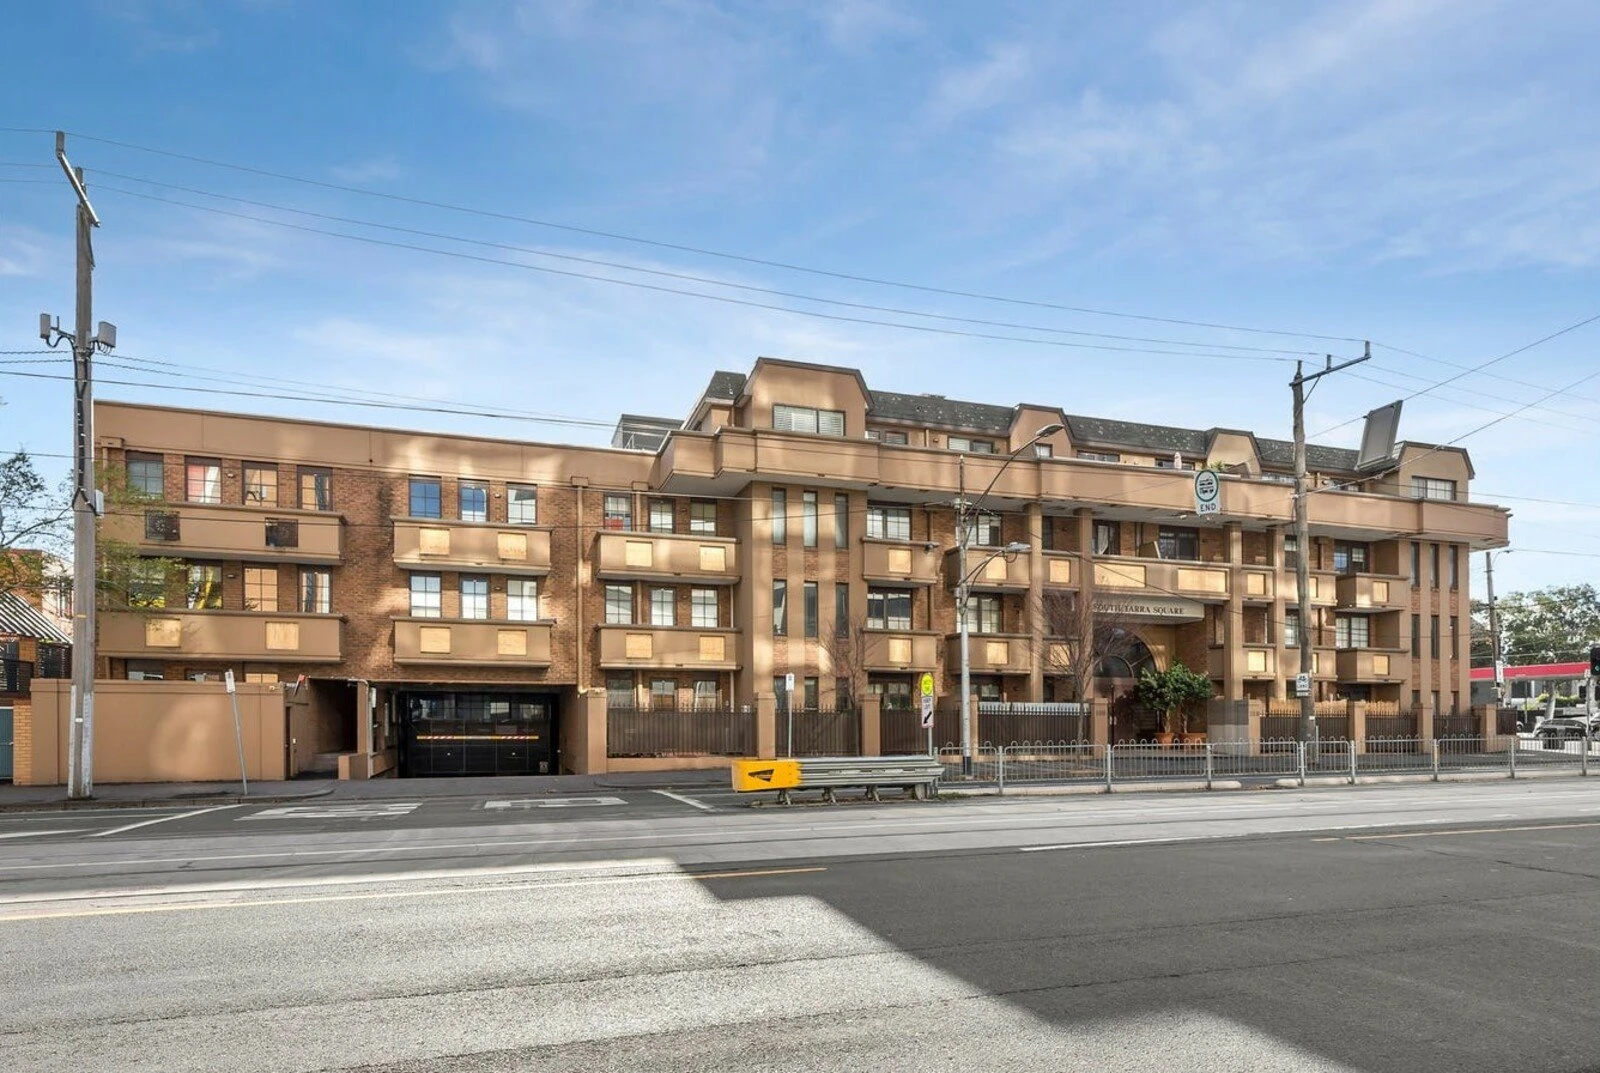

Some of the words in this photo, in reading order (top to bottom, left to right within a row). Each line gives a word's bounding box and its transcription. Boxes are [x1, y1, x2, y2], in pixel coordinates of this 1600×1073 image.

[1200, 503, 1216, 512] END
[1124, 604, 1151, 613] YARRA
[1153, 607, 1184, 615] SQUARE
